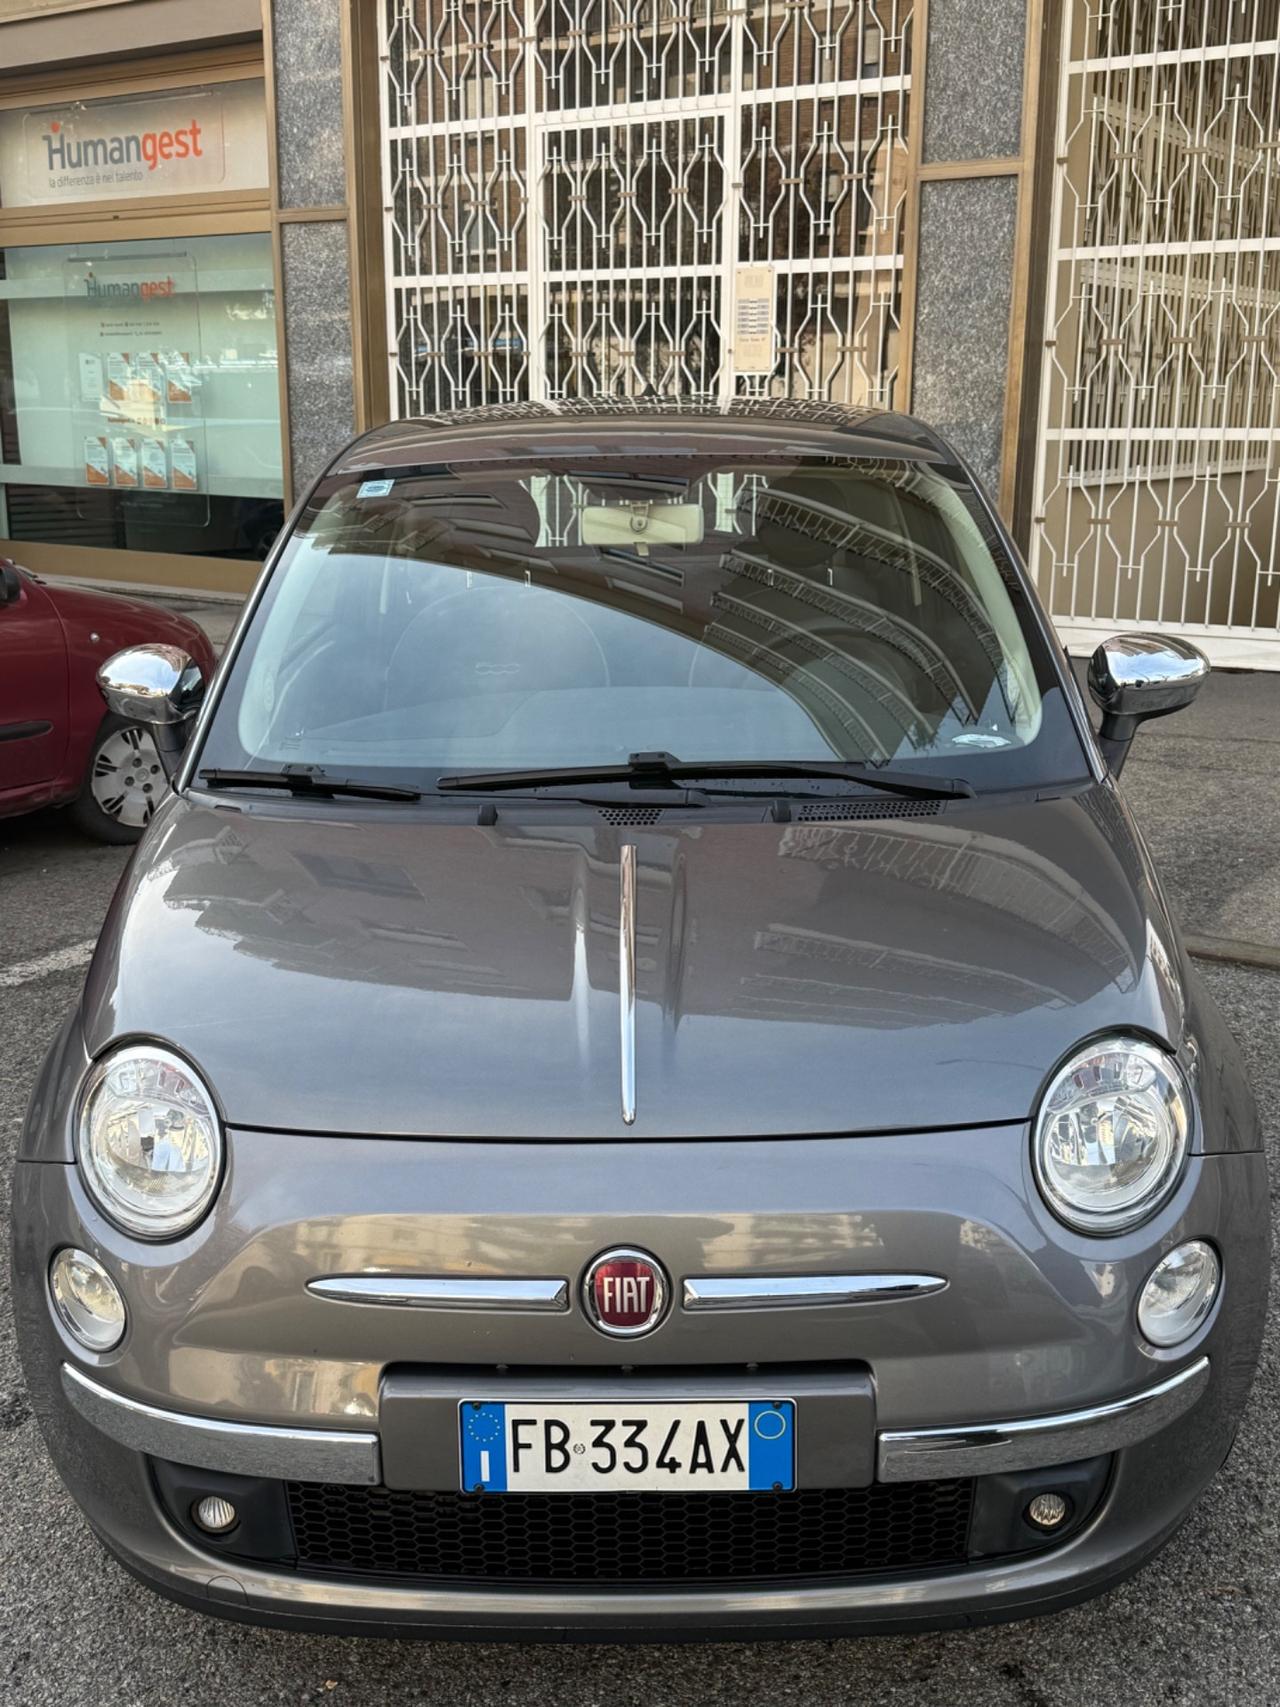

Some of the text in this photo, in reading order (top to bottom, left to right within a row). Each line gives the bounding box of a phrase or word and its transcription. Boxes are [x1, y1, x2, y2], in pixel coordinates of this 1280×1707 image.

[42, 119, 203, 170] Humangest
[84, 271, 175, 300] Humangest
[603, 1276, 650, 1313] FIAT
